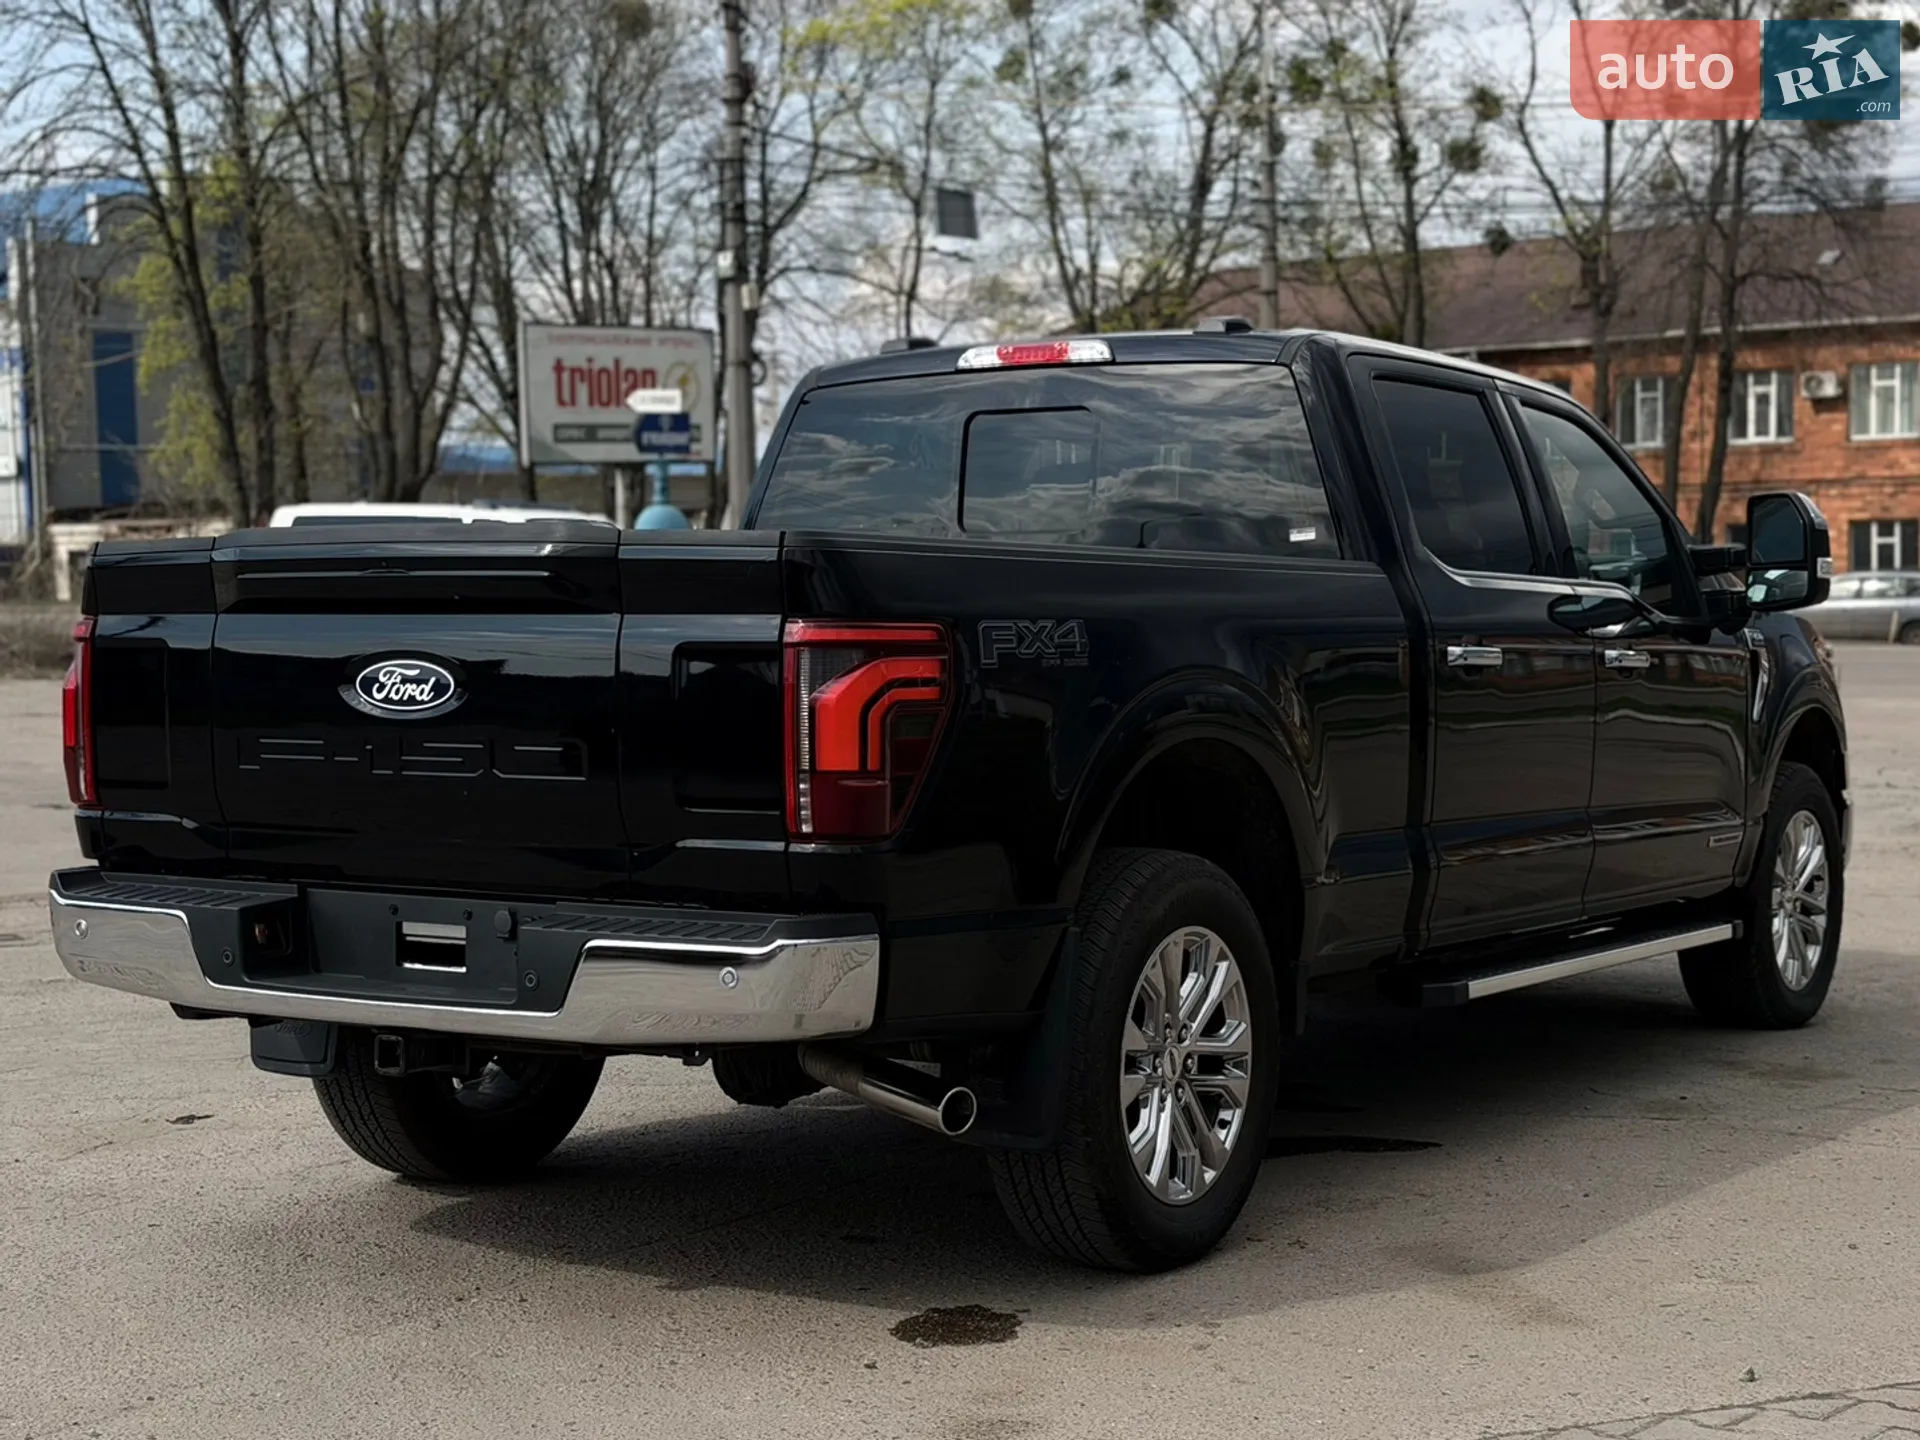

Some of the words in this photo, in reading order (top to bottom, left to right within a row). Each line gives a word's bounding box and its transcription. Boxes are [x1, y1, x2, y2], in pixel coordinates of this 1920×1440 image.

[977, 619, 1089, 668] FX4
[372, 667, 436, 701] Ford
[237, 736, 588, 782] F-150
